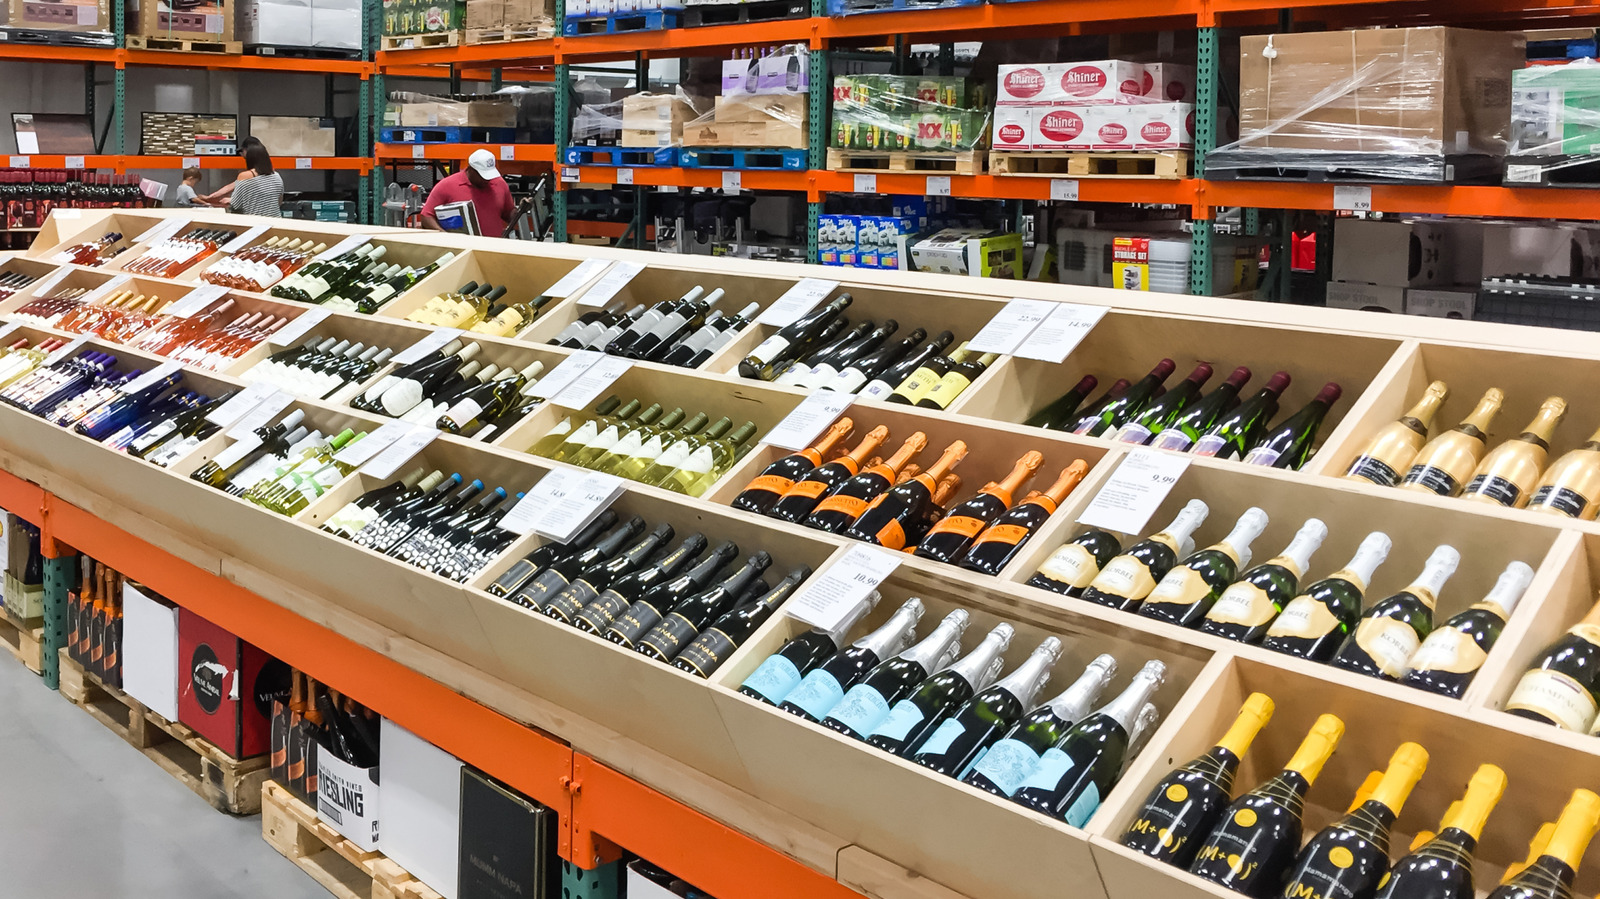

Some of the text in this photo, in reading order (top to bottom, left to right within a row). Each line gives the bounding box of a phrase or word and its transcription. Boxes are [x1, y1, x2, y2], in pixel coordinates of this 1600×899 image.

[1009, 73, 1040, 84] Shiner
[1067, 70, 1100, 83] Shiner
[918, 89, 938, 102] XX
[1045, 116, 1078, 128] Shiner
[917, 122, 942, 138] XX
[1001, 127, 1022, 136] Shiner
[1101, 126, 1124, 135] Shiner
[1143, 125, 1168, 134] Shiner
[1138, 252, 1147, 260] SET
[1068, 320, 1092, 328] 14.99
[824, 406, 841, 414] 9.99
[1152, 474, 1176, 485] 9.99
[1054, 554, 1081, 569] KORBEL
[853, 572, 879, 586] 10.99
[661, 628, 680, 646] NAPA
[698, 644, 718, 662] NAPA
[318, 769, 364, 818] RIESLING
[497, 872, 522, 895] NAPA
